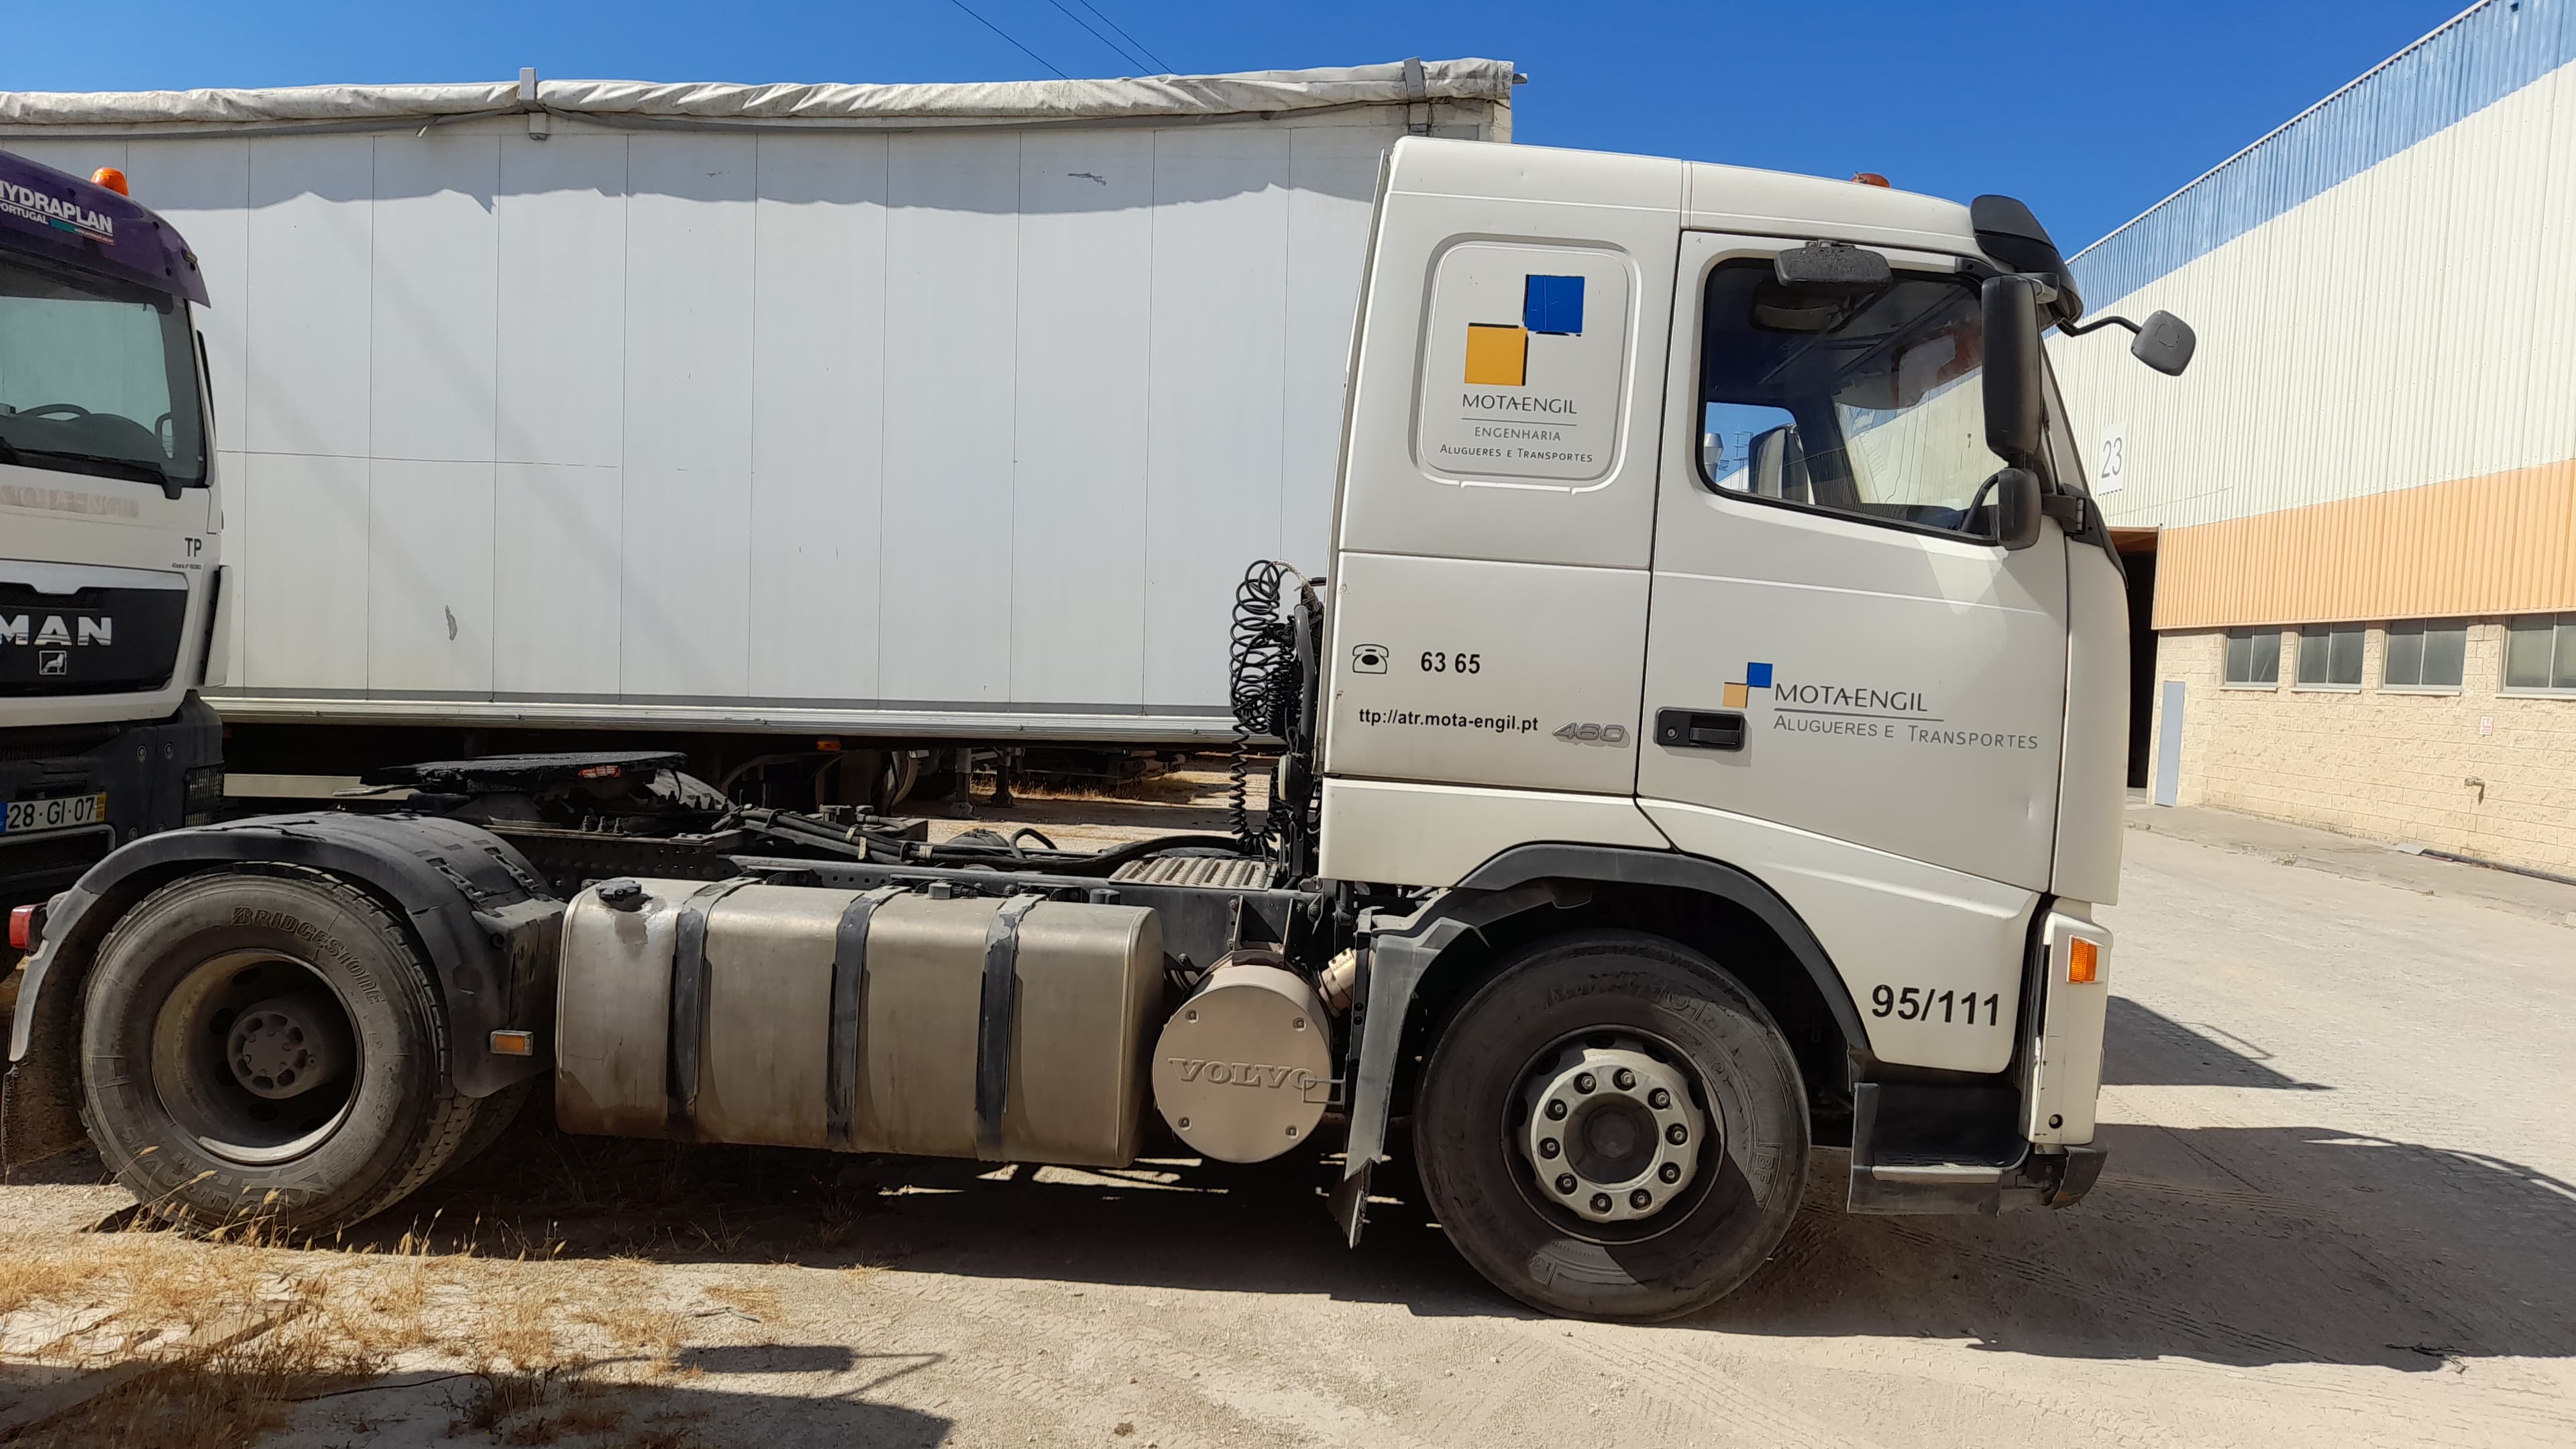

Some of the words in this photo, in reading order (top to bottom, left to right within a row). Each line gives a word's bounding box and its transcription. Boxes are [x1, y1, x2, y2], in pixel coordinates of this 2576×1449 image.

[0, 202, 49, 225] ORTUGAL
[1474, 426, 1561, 441] ENGENHARIA
[2100, 437, 2123, 479] 23
[184, 537, 202, 557] TP
[0, 613, 112, 646] MAN
[1420, 651, 1446, 673] 63
[1454, 653, 1481, 675] 65
[1358, 708, 1539, 734] ttp://atr.mota-engil.pt
[1872, 984, 1999, 1026] 95/111
[1168, 1057, 1318, 1091] VOLVO
